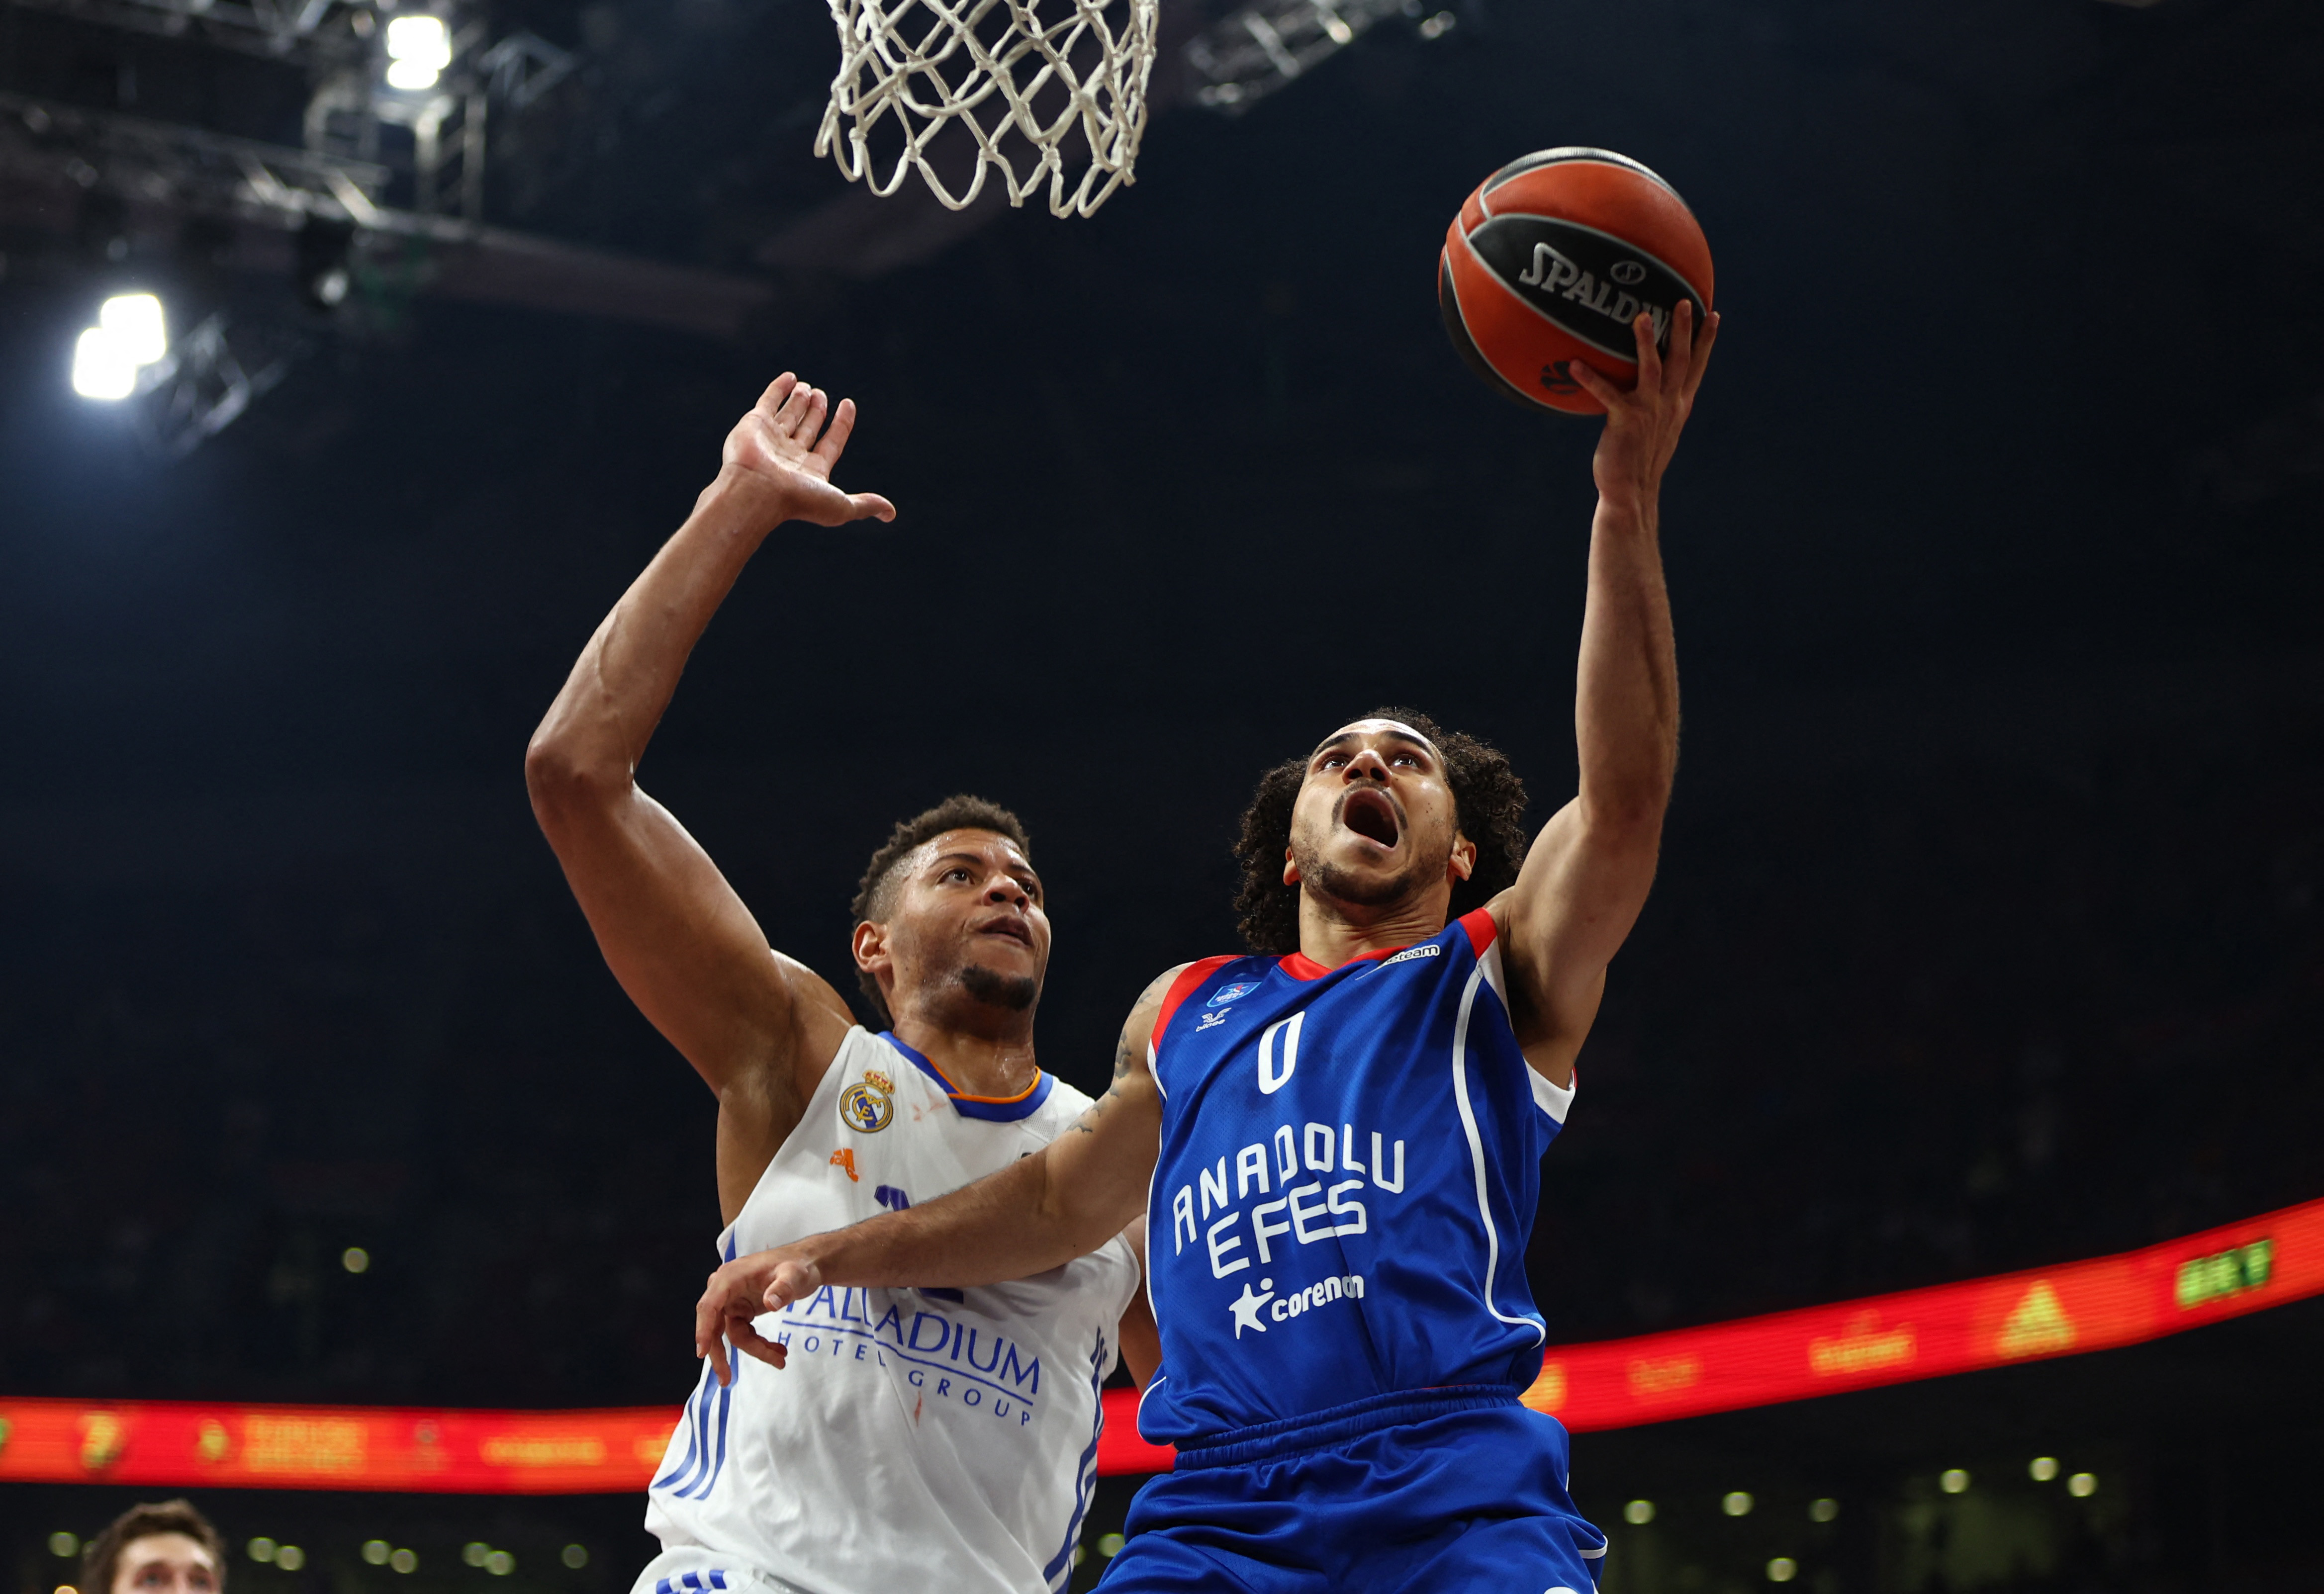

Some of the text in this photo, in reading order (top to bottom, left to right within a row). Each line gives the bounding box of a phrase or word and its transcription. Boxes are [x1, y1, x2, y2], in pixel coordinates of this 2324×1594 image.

[1258, 1011, 1305, 1095] 0
[1173, 1122, 1404, 1256] ANADOLU
[1207, 1179, 1367, 1279] EFES
[778, 1331, 1030, 1426] HOTEL GROUP
[786, 1285, 1039, 1395] ALLADIUM
